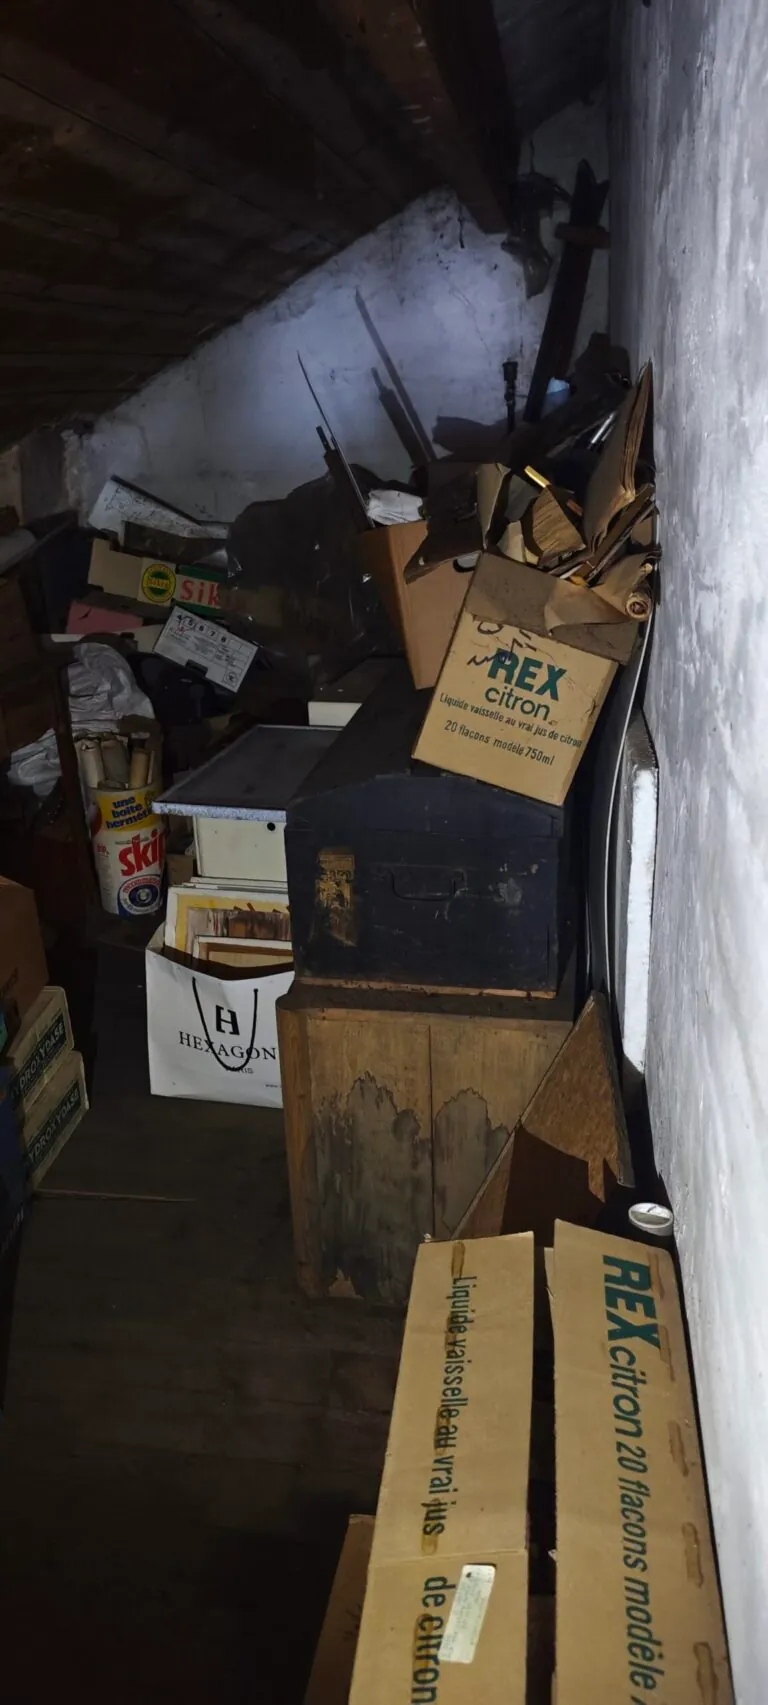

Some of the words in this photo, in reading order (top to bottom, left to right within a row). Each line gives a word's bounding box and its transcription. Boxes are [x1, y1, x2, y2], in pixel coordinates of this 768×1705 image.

[487, 648, 567, 701] REX
[439, 692, 469, 711] Liquide
[470, 704, 503, 722] vaisselle
[505, 716, 516, 726] au
[518, 719, 534, 732] vrai
[534, 726, 547, 738] jus
[548, 729, 558, 740] de
[560, 734, 582, 748] citron
[485, 686, 550, 721] citron
[444, 720, 457, 733] 20
[459, 724, 490, 744] flacons
[525, 746, 556, 766] 750ml
[112, 795, 136, 809] une
[215, 1004, 240, 1036] H
[178, 1030, 277, 1061] HEXAGON
[446, 1276, 477, 1335] Liquide
[602, 1254, 661, 1350] REX
[441, 1335, 472, 1419] vaisselle
[608, 1345, 647, 1438] citron
[435, 1424, 459, 1452] au
[616, 1440, 648, 1474] 20
[429, 1455, 459, 1495] vrai
[421, 1500, 457, 1536] jus
[618, 1476, 651, 1573] flacons
[422, 1576, 457, 1608] de
[411, 1613, 444, 1705] citron
